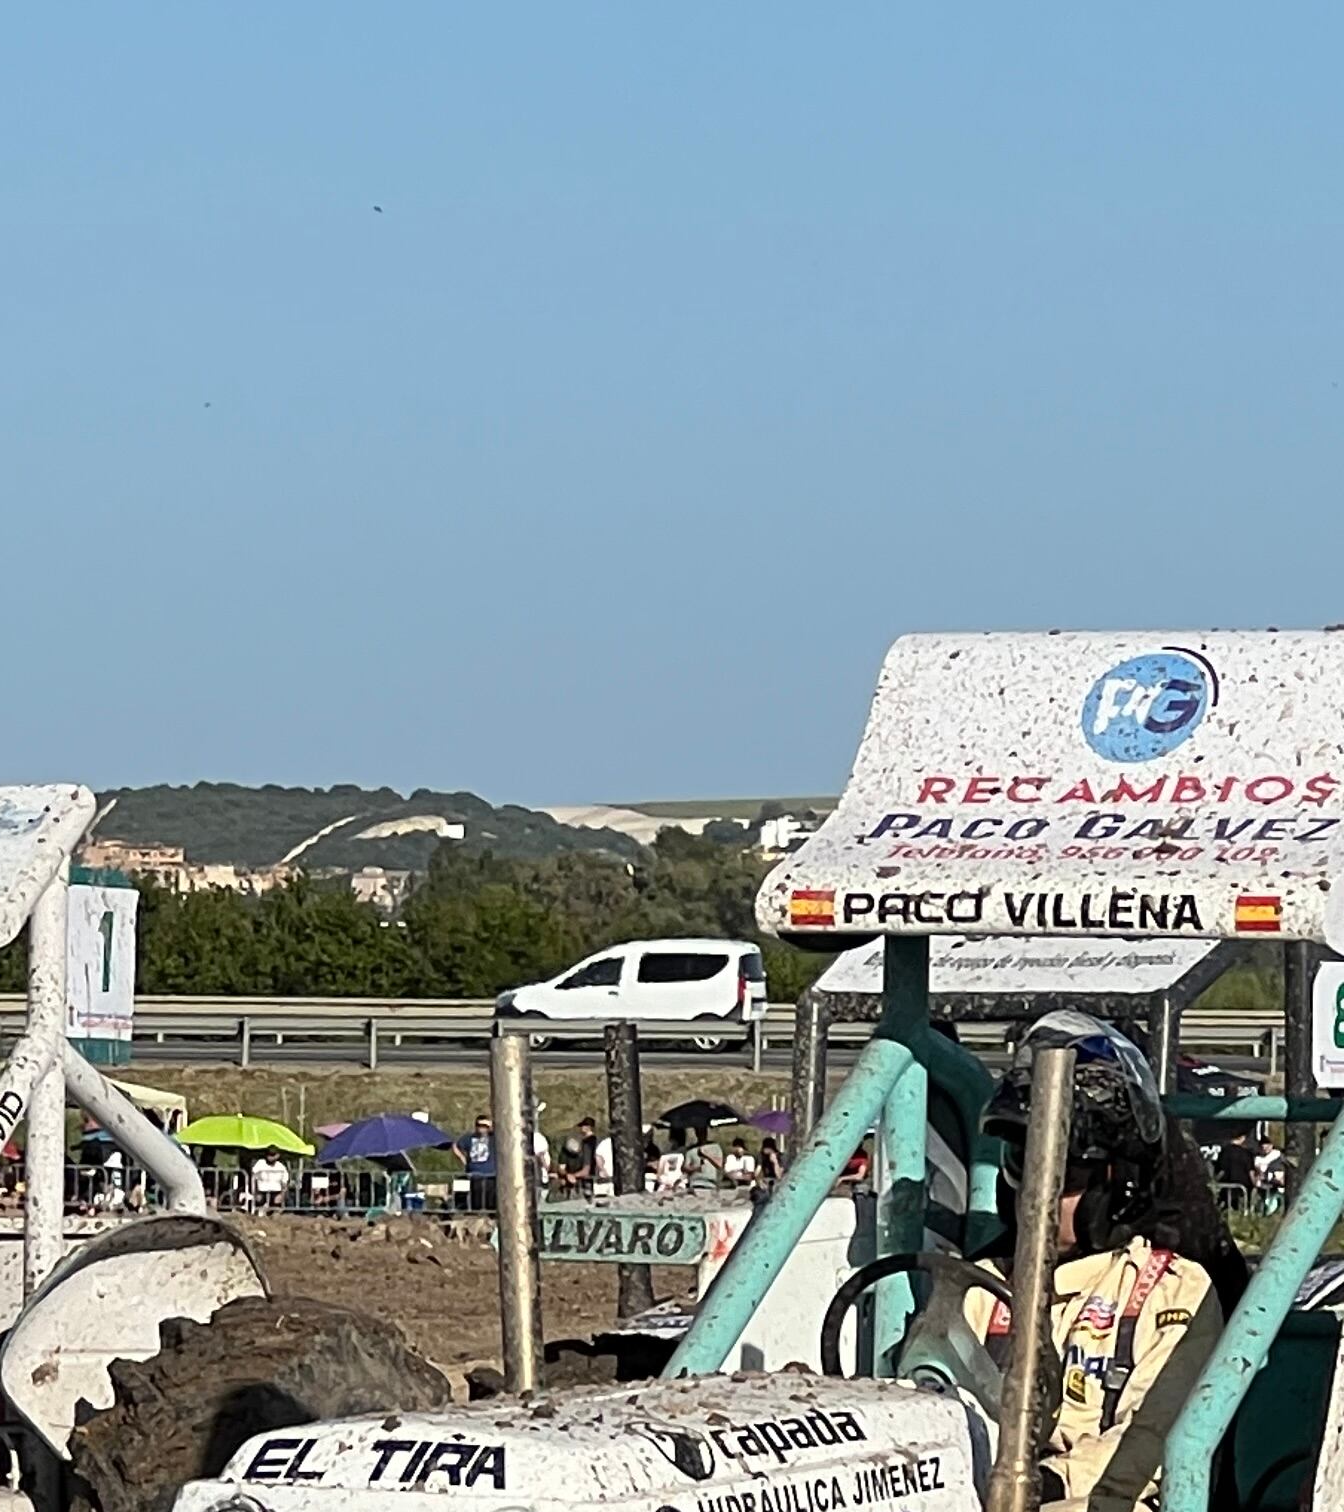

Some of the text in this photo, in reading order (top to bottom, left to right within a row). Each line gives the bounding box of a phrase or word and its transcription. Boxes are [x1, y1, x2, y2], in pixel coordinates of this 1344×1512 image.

[916, 774, 1342, 804] RECAMBIOS
[868, 812, 1050, 840] PACO
[843, 892, 1205, 932] PACO VILLENA
[98, 911, 113, 992] 1
[242, 1438, 506, 1490] EL TIRA
[852, 1457, 945, 1505] JIMENEZ
